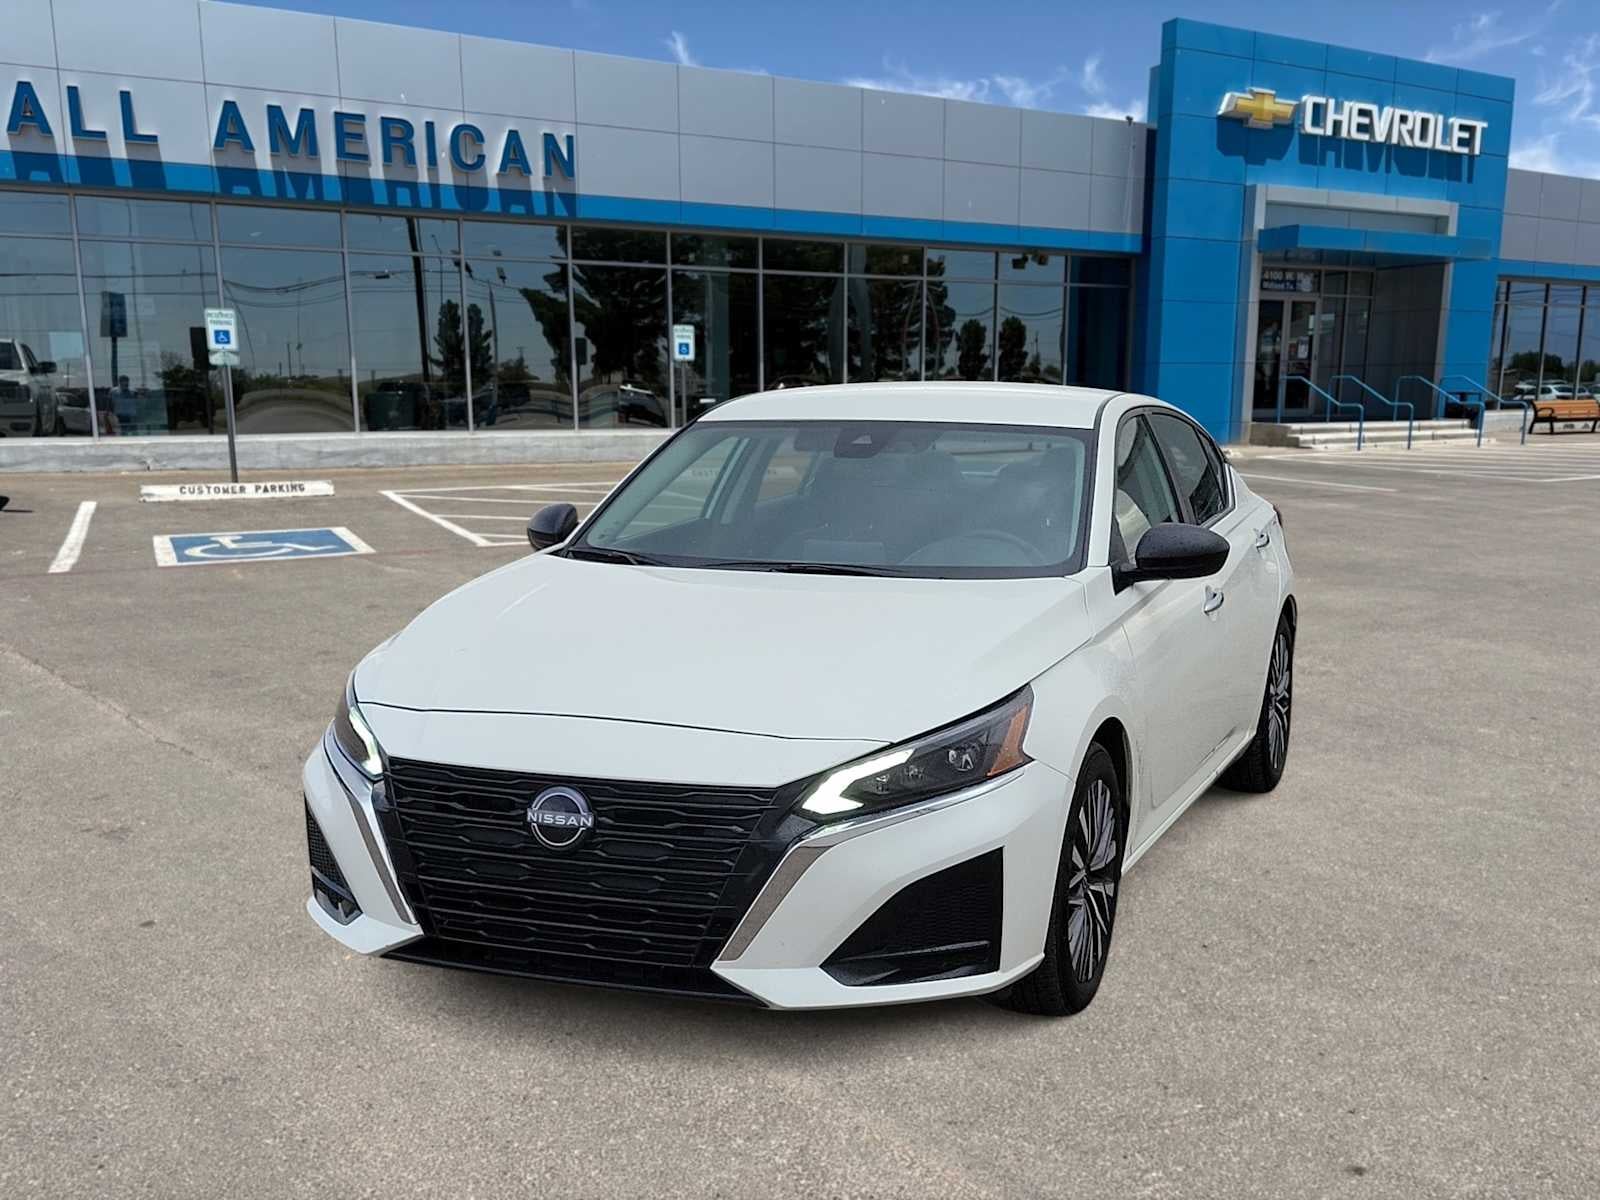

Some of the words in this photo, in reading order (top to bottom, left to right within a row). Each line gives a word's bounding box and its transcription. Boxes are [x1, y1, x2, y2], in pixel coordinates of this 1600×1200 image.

[7, 81, 158, 144] ALL
[212, 99, 575, 179] AMERICAN
[1301, 94, 1489, 156] CHEVROLET
[179, 485, 246, 496] CUSTOMER
[254, 483, 306, 494] PARKING
[526, 811, 593, 827] NISSAN
